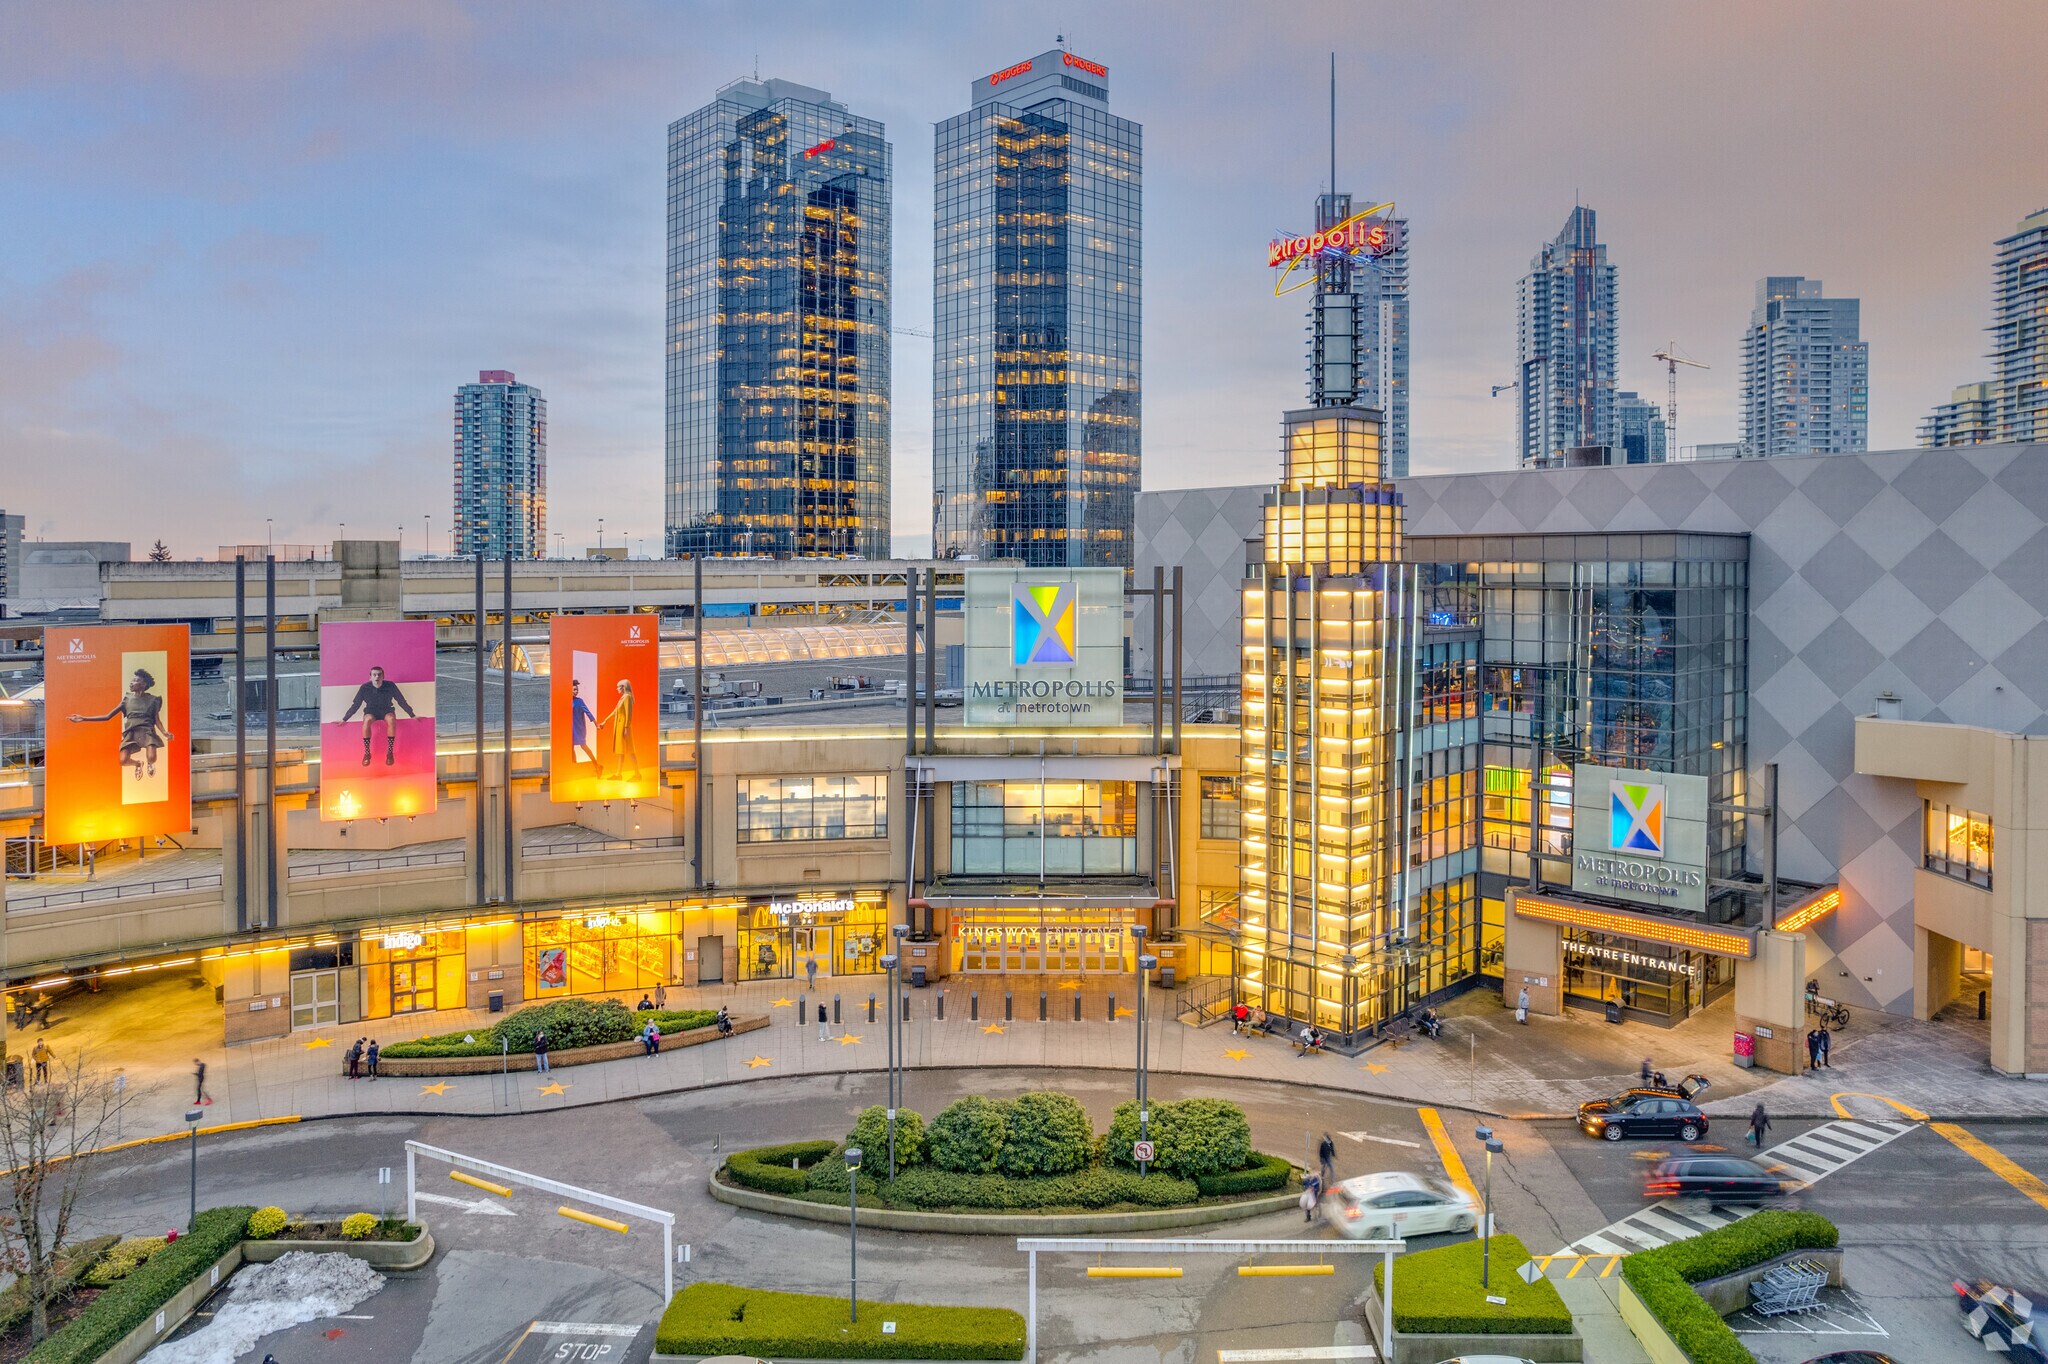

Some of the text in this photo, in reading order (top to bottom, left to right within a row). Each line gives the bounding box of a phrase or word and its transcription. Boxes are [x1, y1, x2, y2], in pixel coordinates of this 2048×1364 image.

[1000, 60, 1032, 82] ROGERS
[1073, 57, 1106, 77] ROGERS
[972, 680, 1116, 698] METROPOLIS
[997, 701, 1091, 713] at metrotown
[1577, 854, 1701, 887] METROPOLIS
[1596, 874, 1678, 897] at metrotown
[769, 899, 855, 915] McDonald's
[957, 926, 1125, 937] KINGSWAY ENTRANCE
[1561, 940, 1696, 976] THEATRE ENTRANCE
[554, 1342, 612, 1360] STOP
